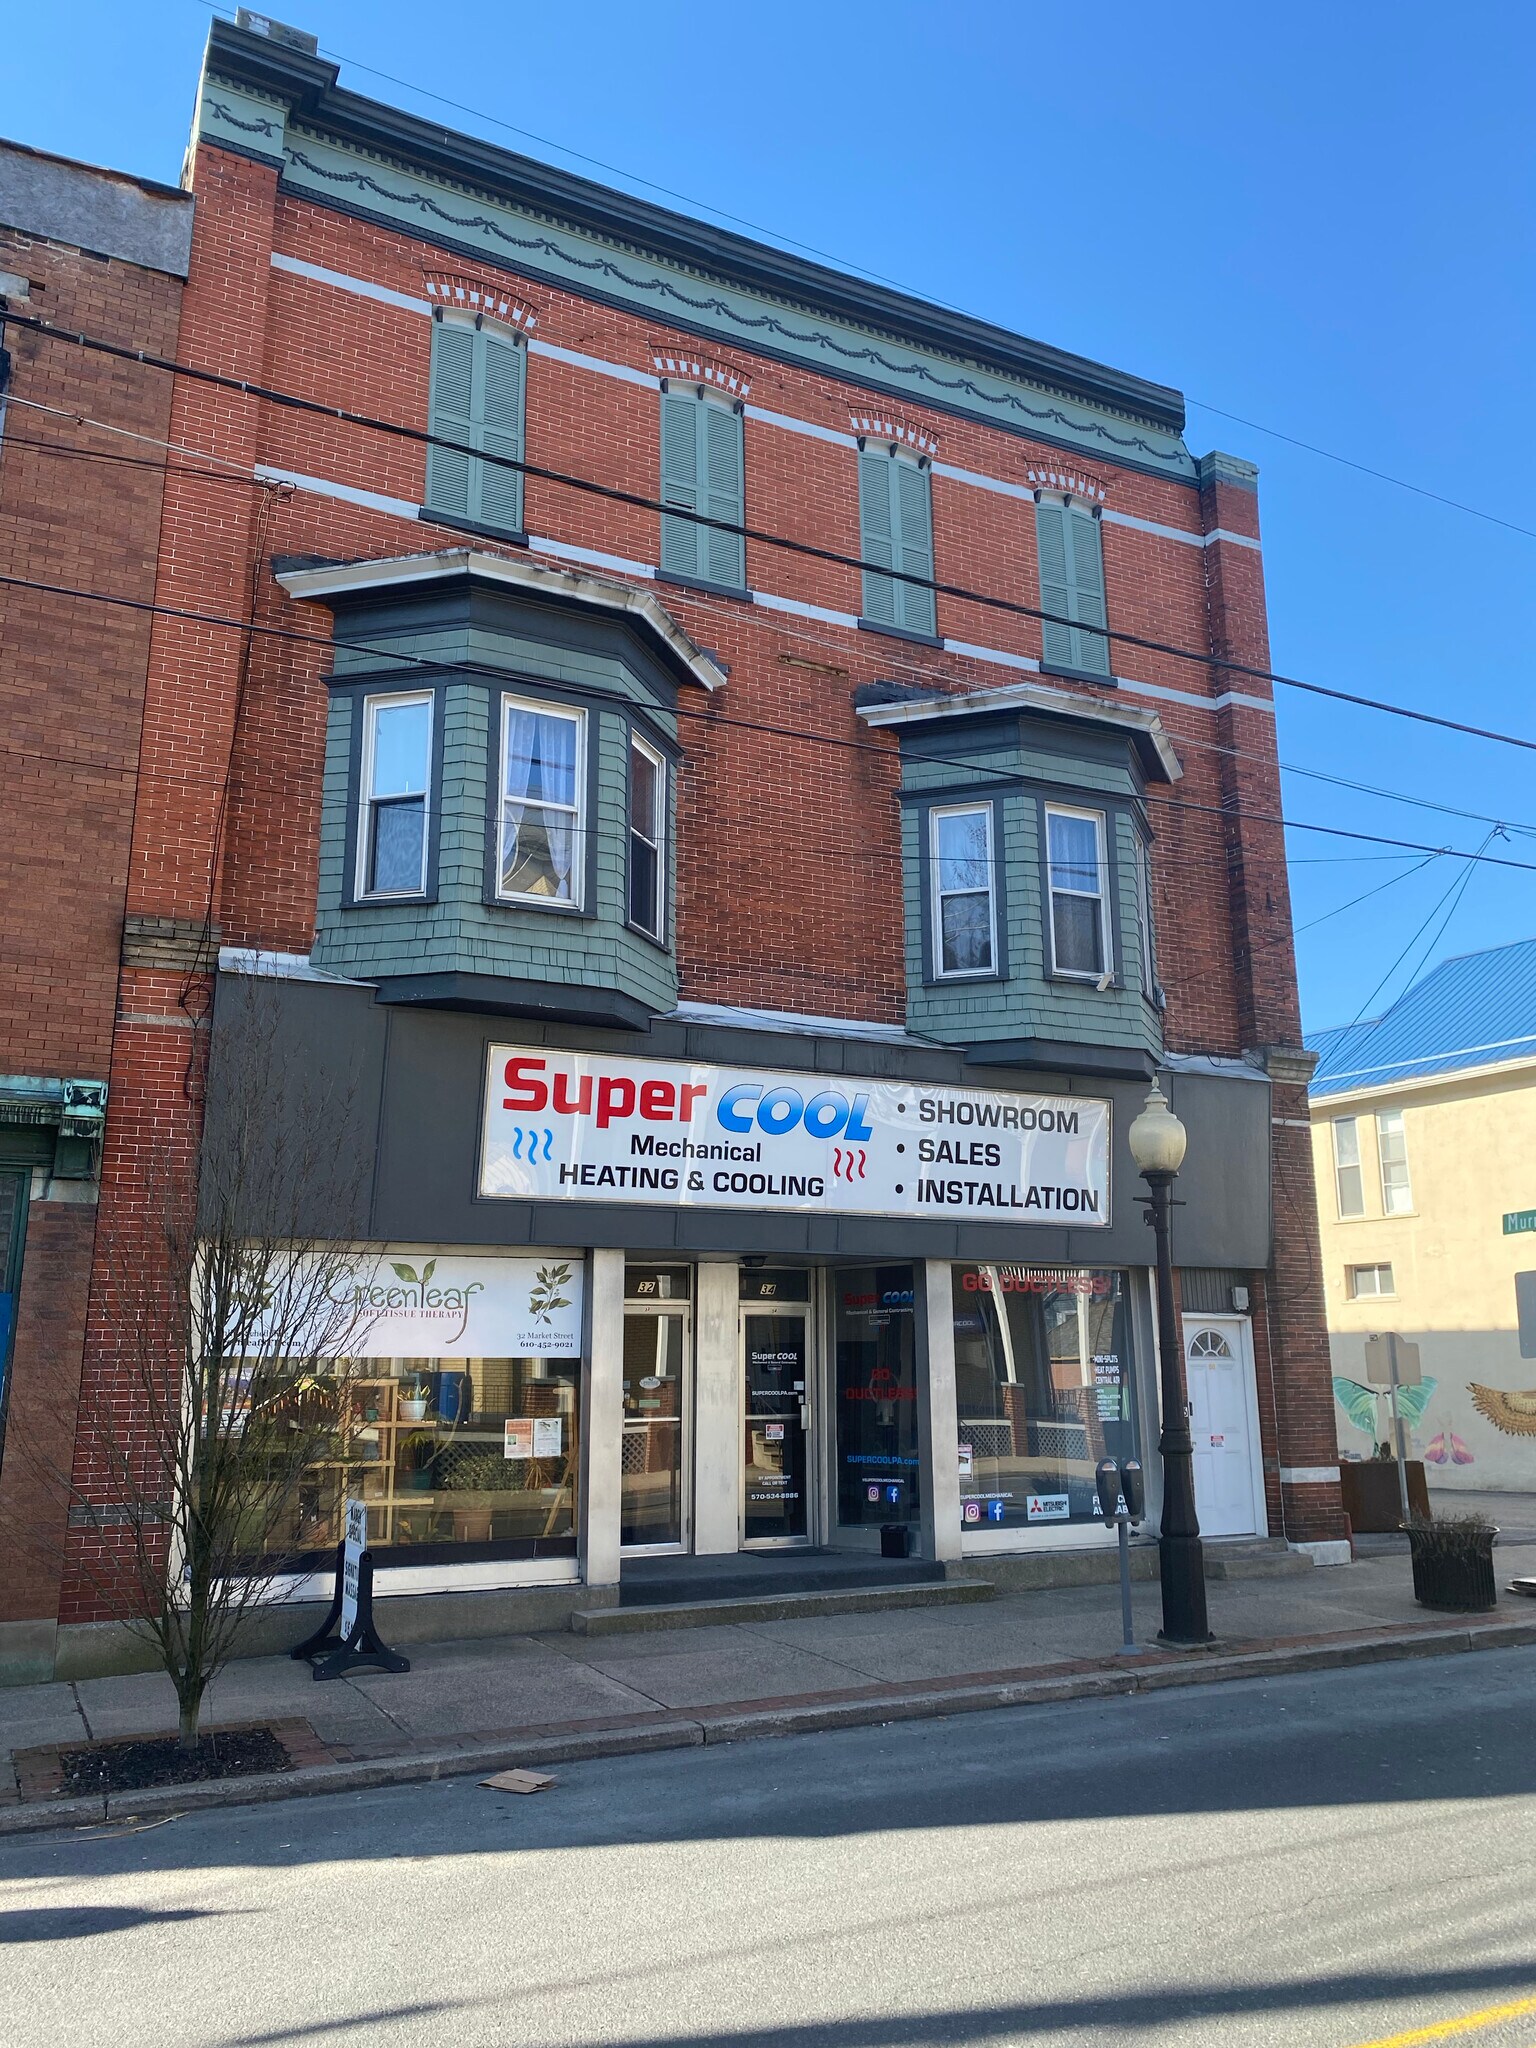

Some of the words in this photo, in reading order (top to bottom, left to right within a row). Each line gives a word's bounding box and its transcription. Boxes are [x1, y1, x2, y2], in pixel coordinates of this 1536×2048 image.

[502, 1057, 707, 1129] Super
[717, 1083, 873, 1142] COOL
[918, 1099, 1079, 1134] SHOWROOM
[630, 1134, 761, 1162] Mechanical
[918, 1139, 1001, 1167] SALES
[559, 1163, 679, 1190] HEATING
[687, 1171, 705, 1191] &
[713, 1172, 824, 1198] COOLING
[917, 1179, 1099, 1212] INSTALLATION
[639, 1282, 654, 1292] 32
[761, 1284, 775, 1294] 34
[962, 1273, 993, 1292] GO
[326, 1262, 485, 1345] Greenleaf
[358, 1310, 383, 1318] SOFT
[384, 1310, 416, 1318] TISSUE
[420, 1310, 464, 1318] THERAPY
[520, 1340, 573, 1349] 610-452-9021
[527, 1332, 552, 1340] Market
[553, 1332, 574, 1340] Street
[751, 1351, 777, 1361] Super
[777, 1352, 798, 1360] COOL
[846, 1454, 920, 1466] SUPERCOOLPA.com
